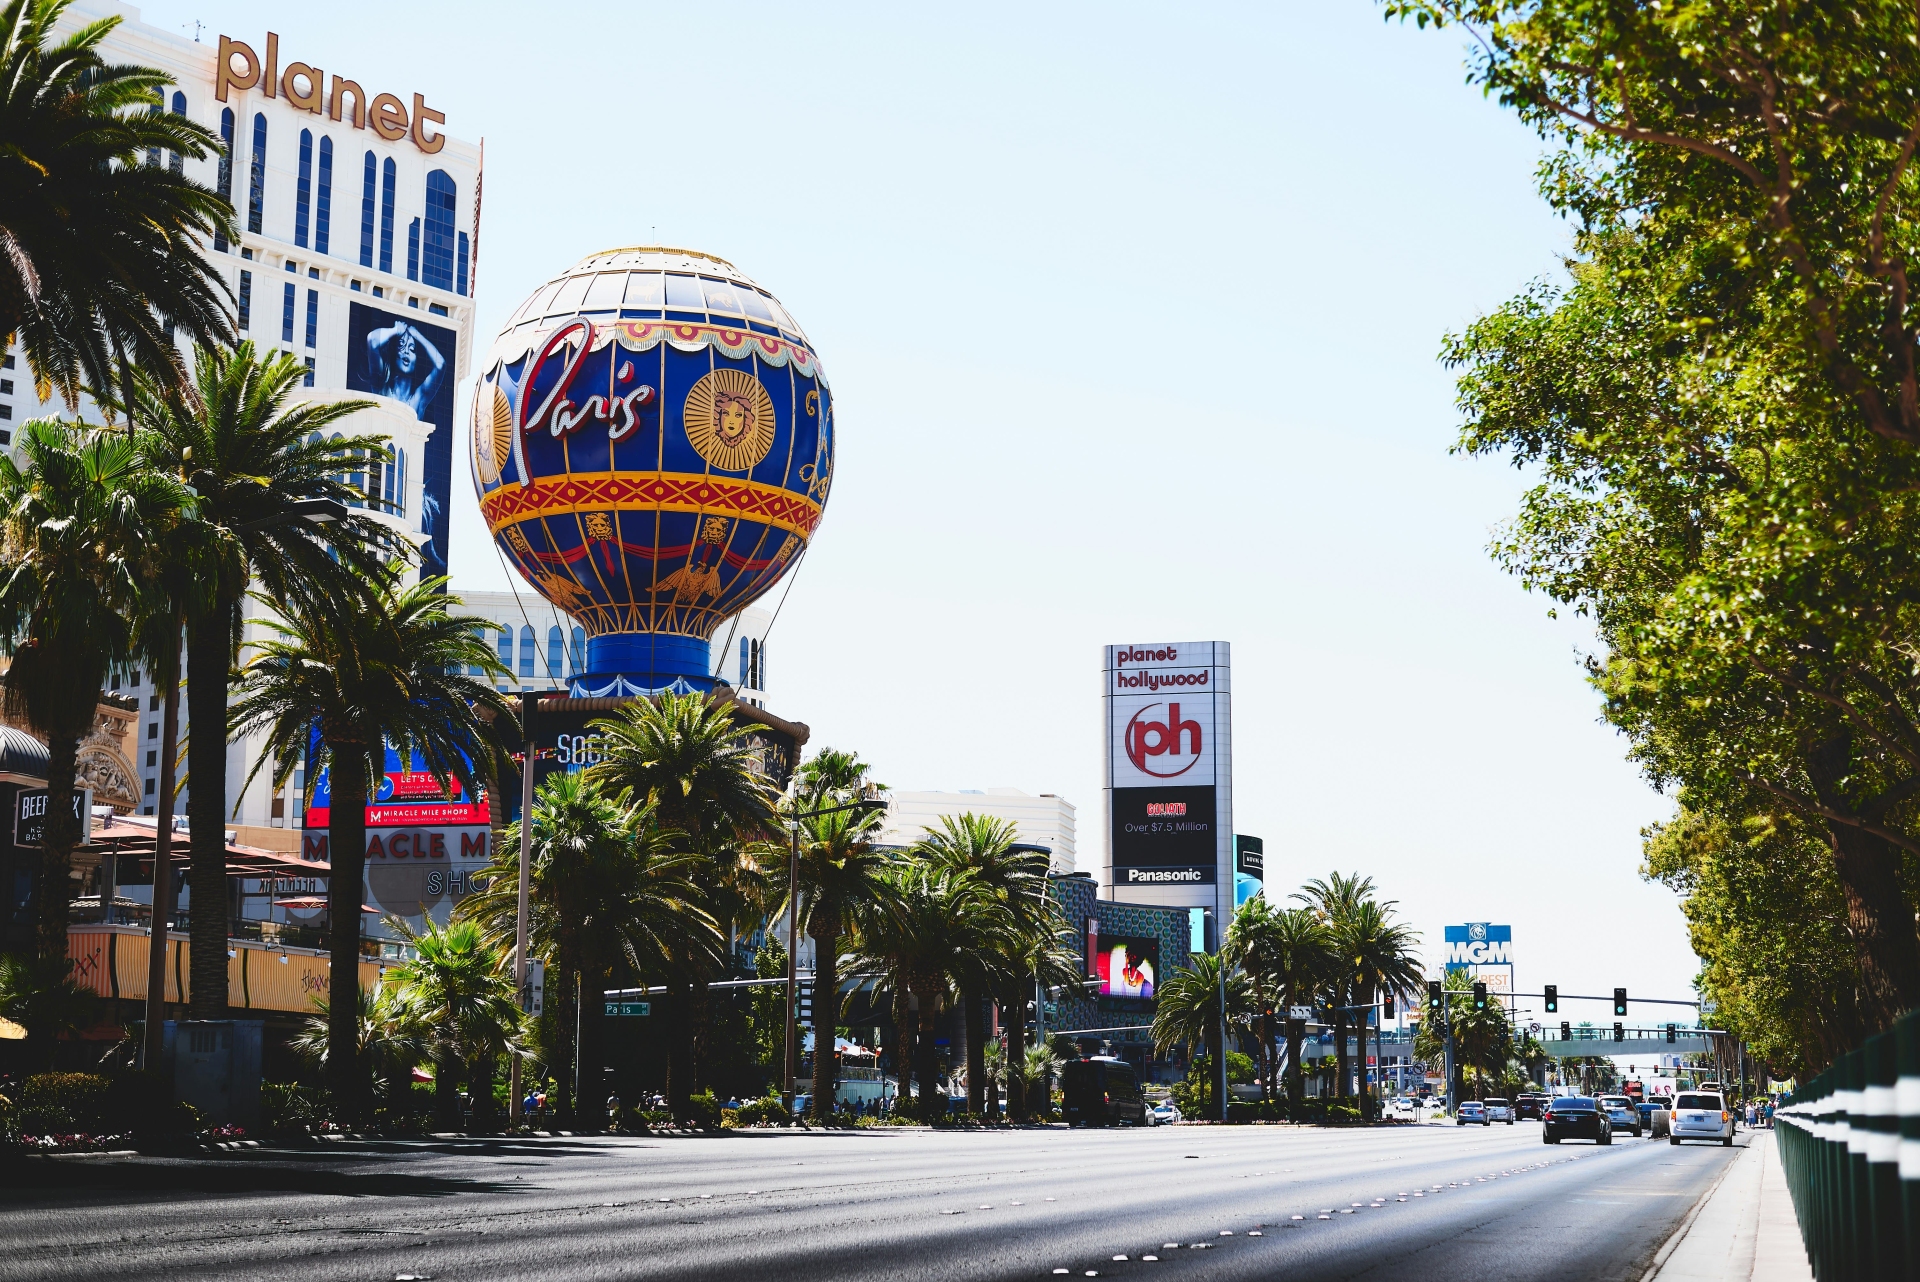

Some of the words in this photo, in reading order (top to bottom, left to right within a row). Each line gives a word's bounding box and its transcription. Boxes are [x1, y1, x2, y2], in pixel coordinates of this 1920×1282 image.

[215, 31, 446, 154] planet
[514, 316, 656, 490] Paris
[1117, 646, 1177, 667] planet
[1117, 670, 1208, 691] hollywood
[1133, 703, 1202, 770] ph
[400, 774, 425, 784] LET'S
[1147, 803, 1187, 815] GOLIATH
[1125, 823, 1148, 833] Over
[1151, 822, 1173, 832] $7.5
[1176, 821, 1208, 831] Million
[303, 833, 445, 859] MACLE
[1128, 868, 1202, 882] Panasonic
[1444, 941, 1514, 964] MGM
[1480, 974, 1509, 986] BEST
